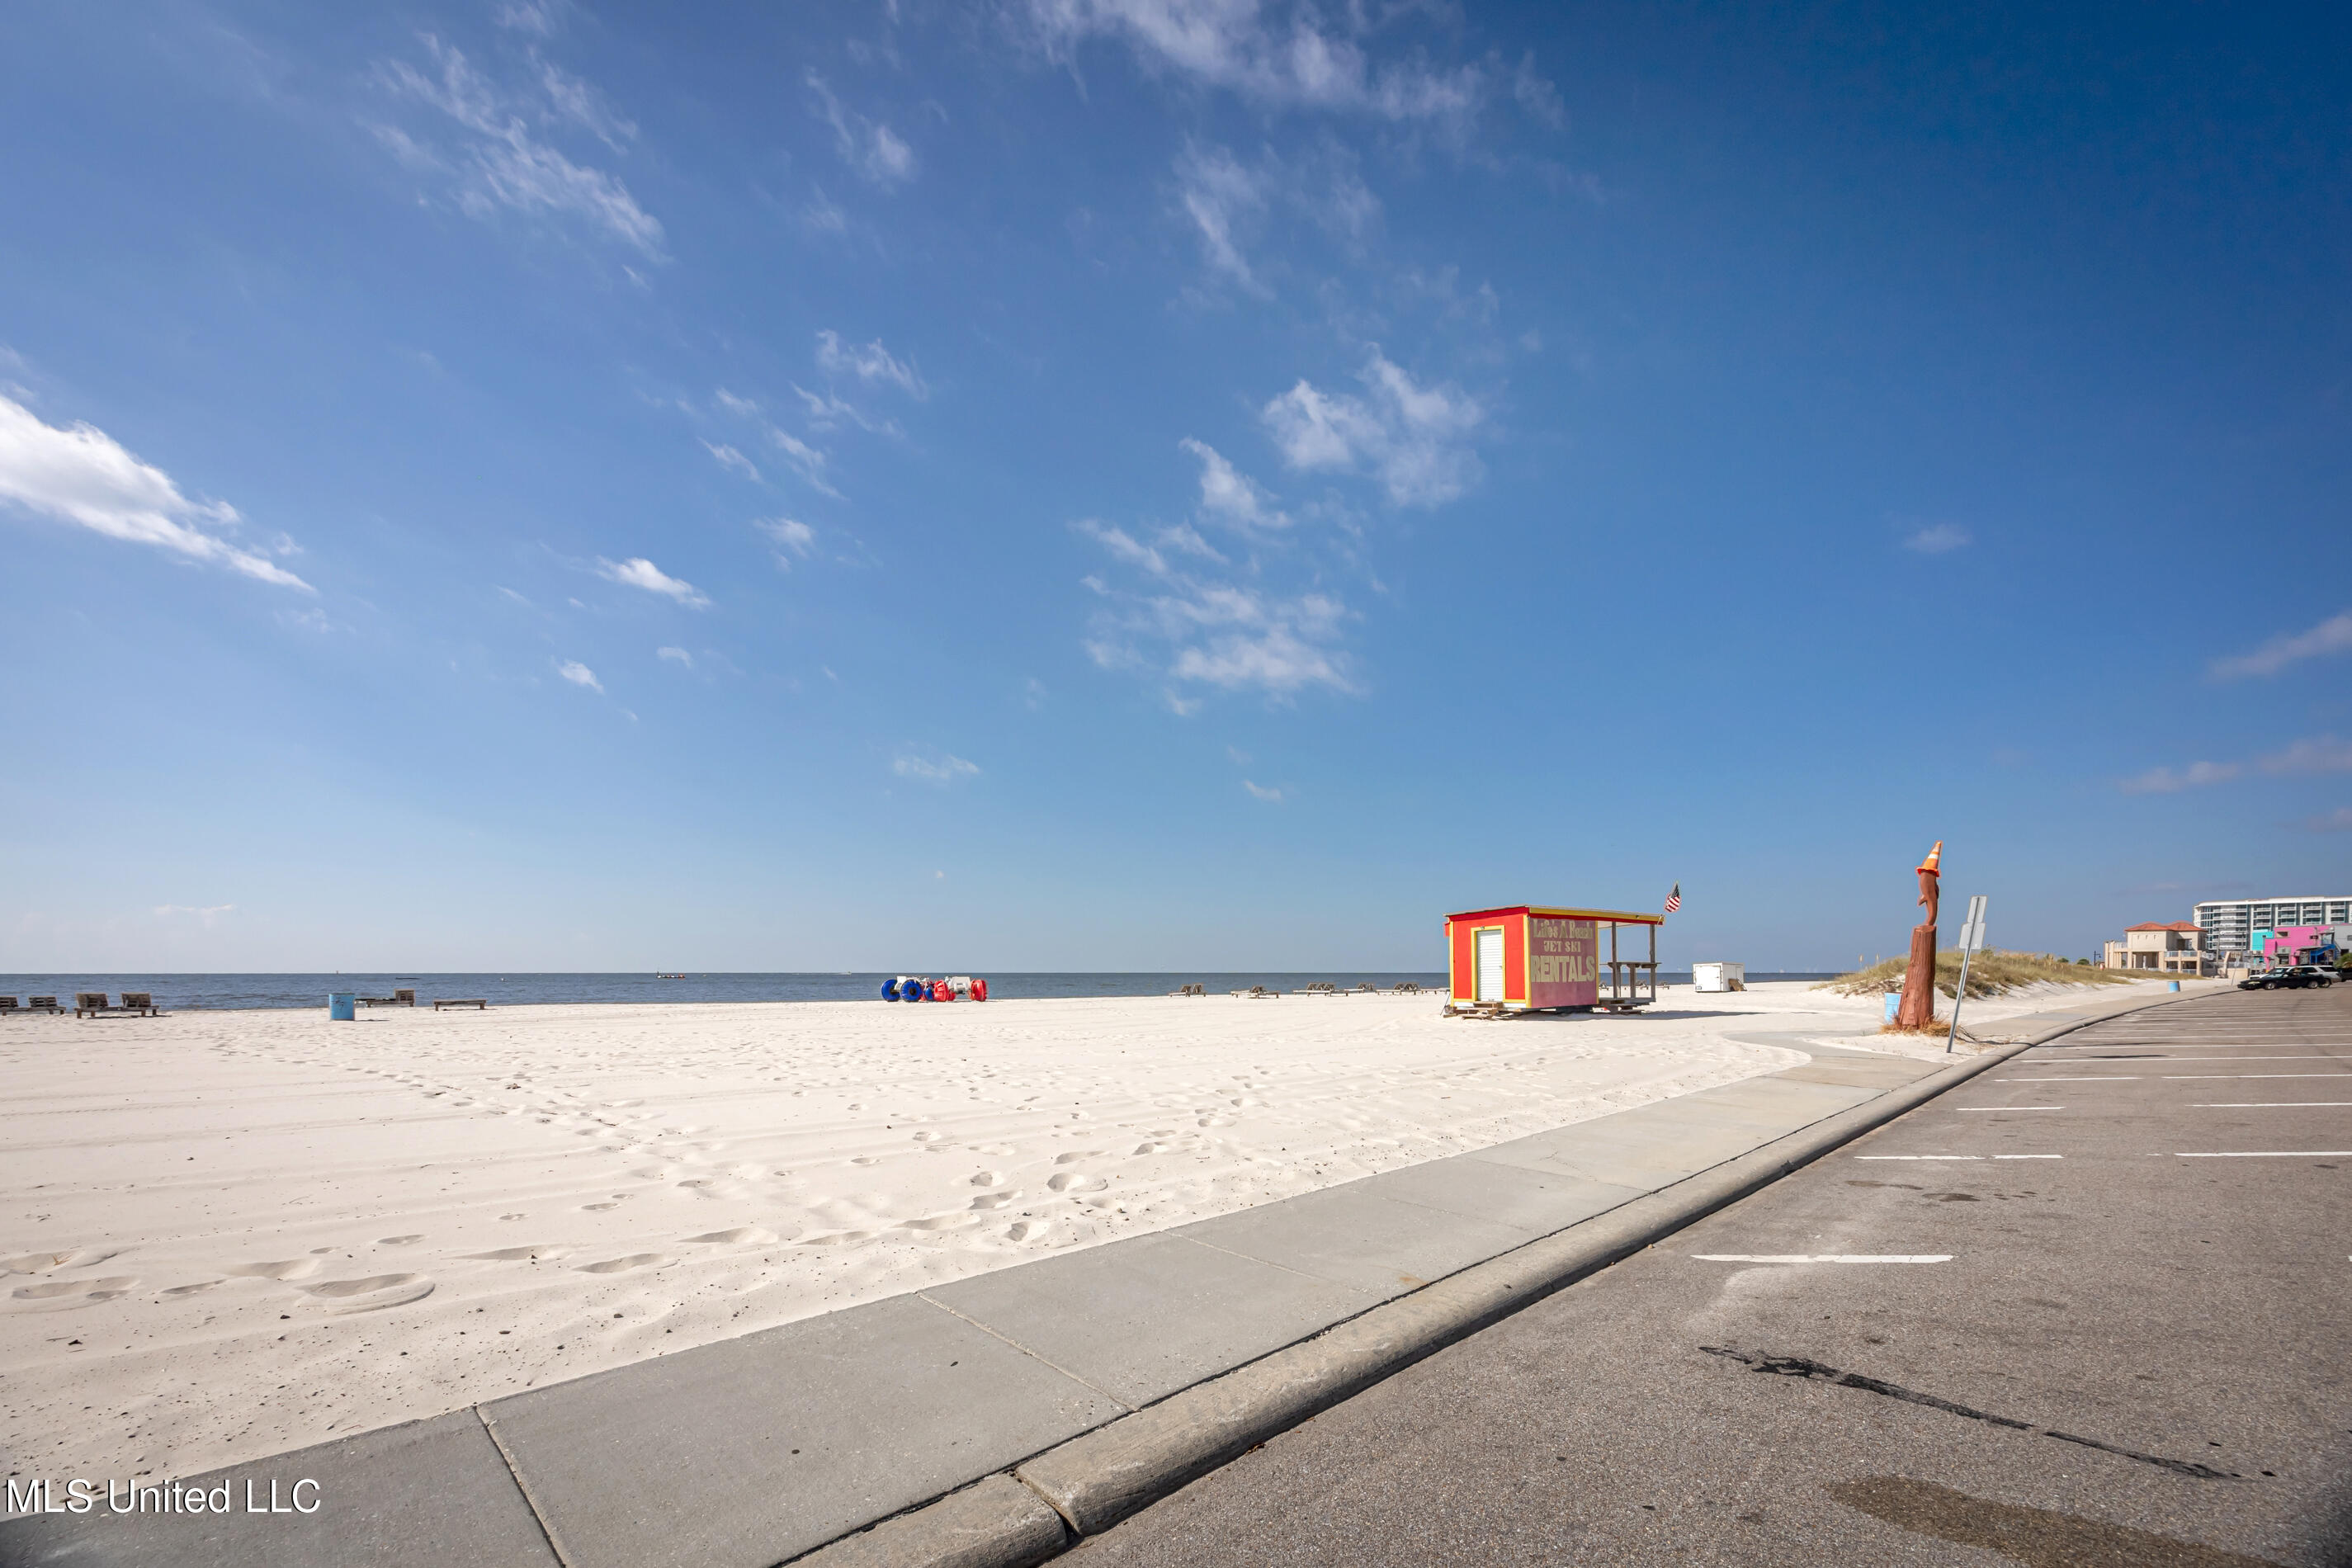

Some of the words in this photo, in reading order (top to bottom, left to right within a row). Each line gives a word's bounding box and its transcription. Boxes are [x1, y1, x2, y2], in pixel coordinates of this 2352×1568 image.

[1560, 920, 1568, 938] A
[1543, 940, 1562, 952] JET
[1565, 941, 1581, 952] SKI
[1531, 955, 1595, 983] RENTALS
